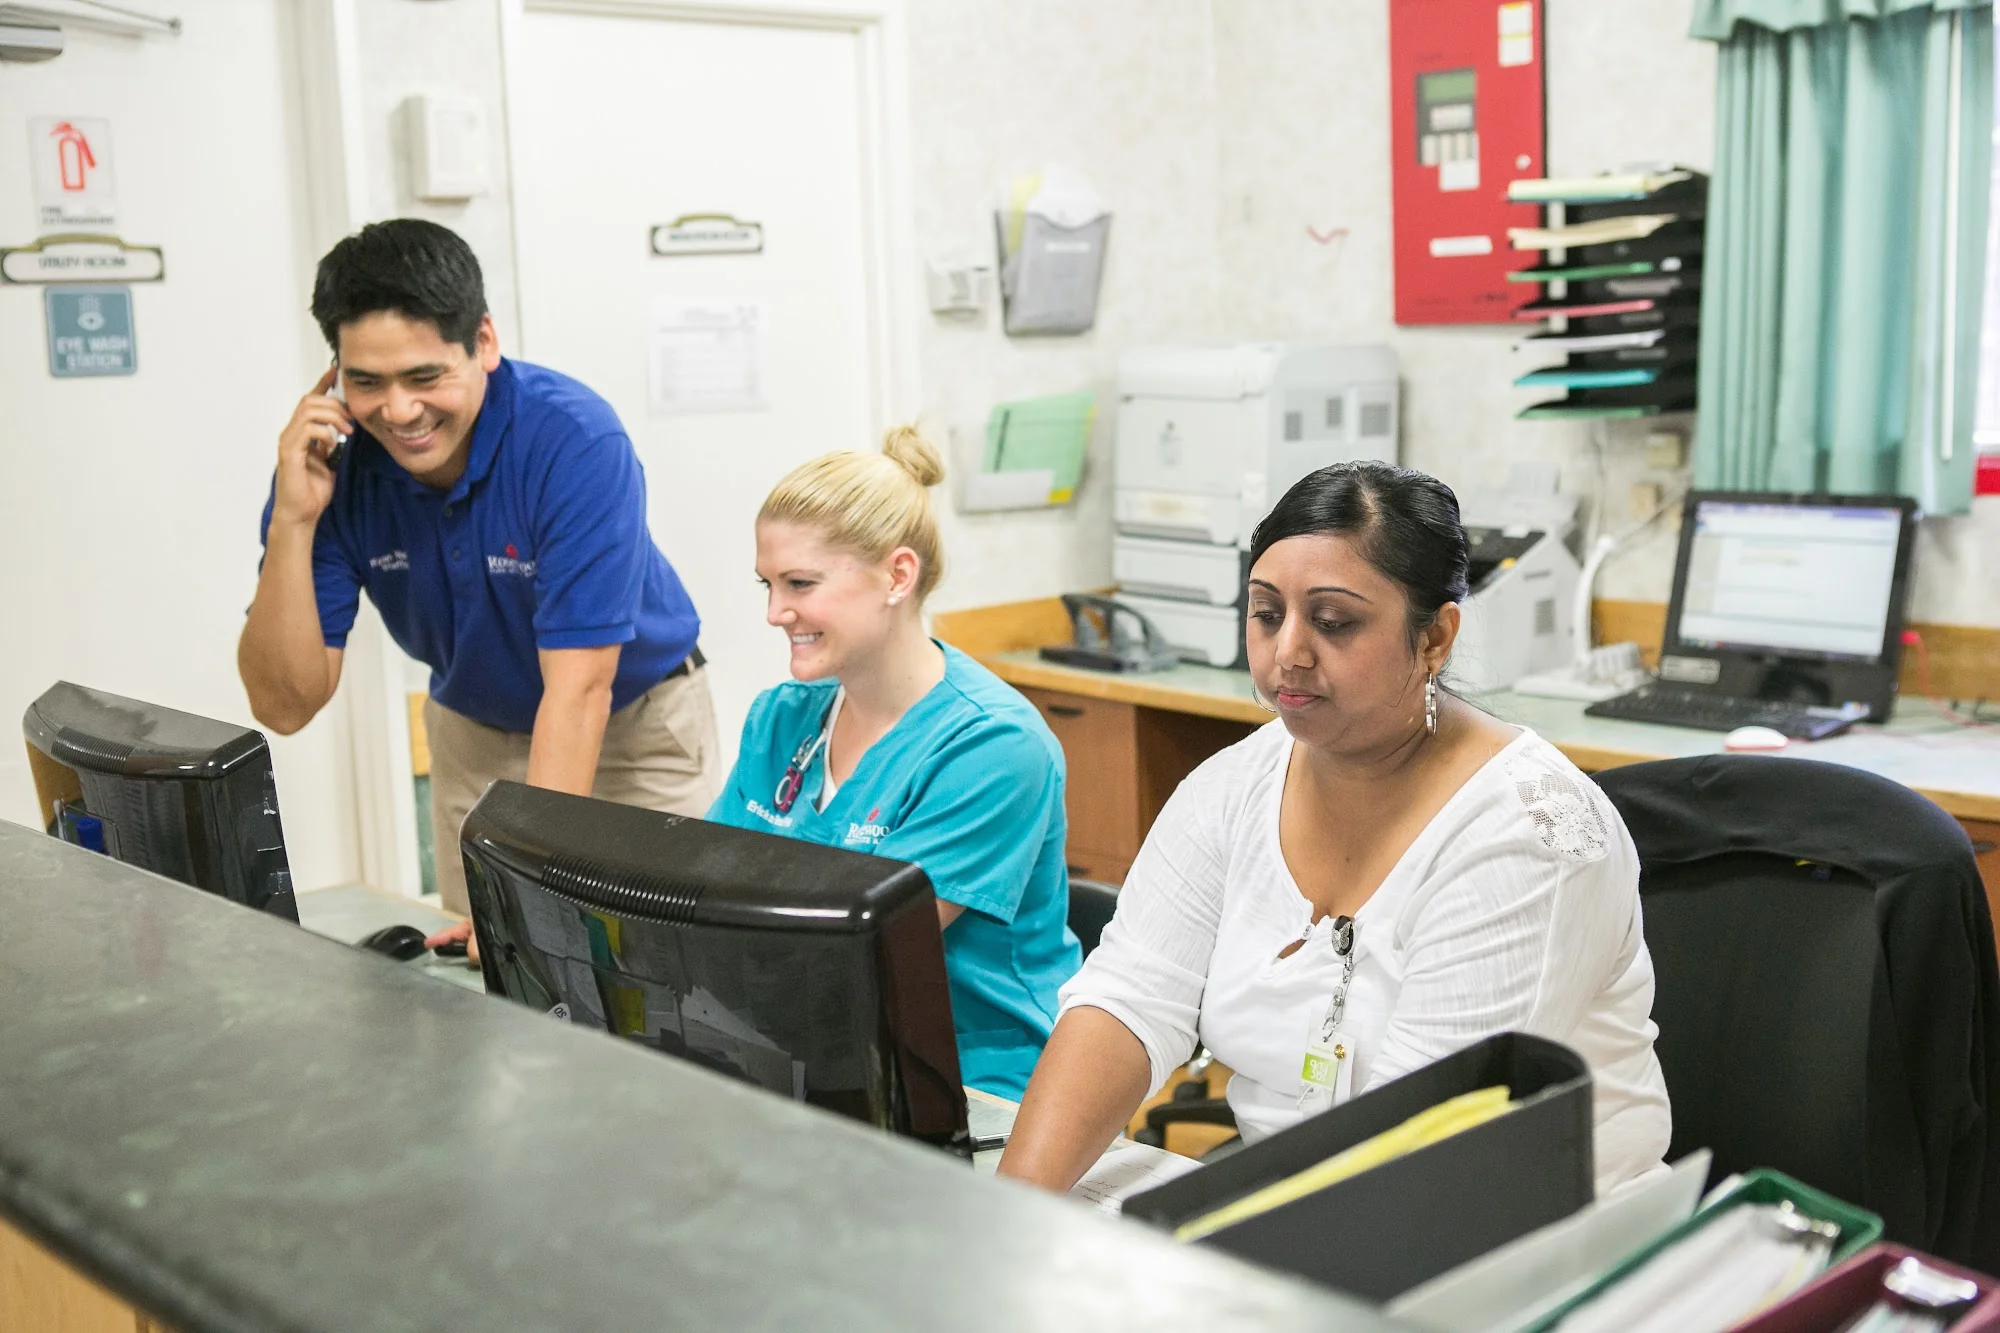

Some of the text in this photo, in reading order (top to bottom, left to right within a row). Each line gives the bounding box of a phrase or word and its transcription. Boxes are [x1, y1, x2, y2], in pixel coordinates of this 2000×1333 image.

[83, 255, 126, 268] ROOM
[57, 335, 128, 354] EYE WASH
[66, 352, 123, 370] STATION
